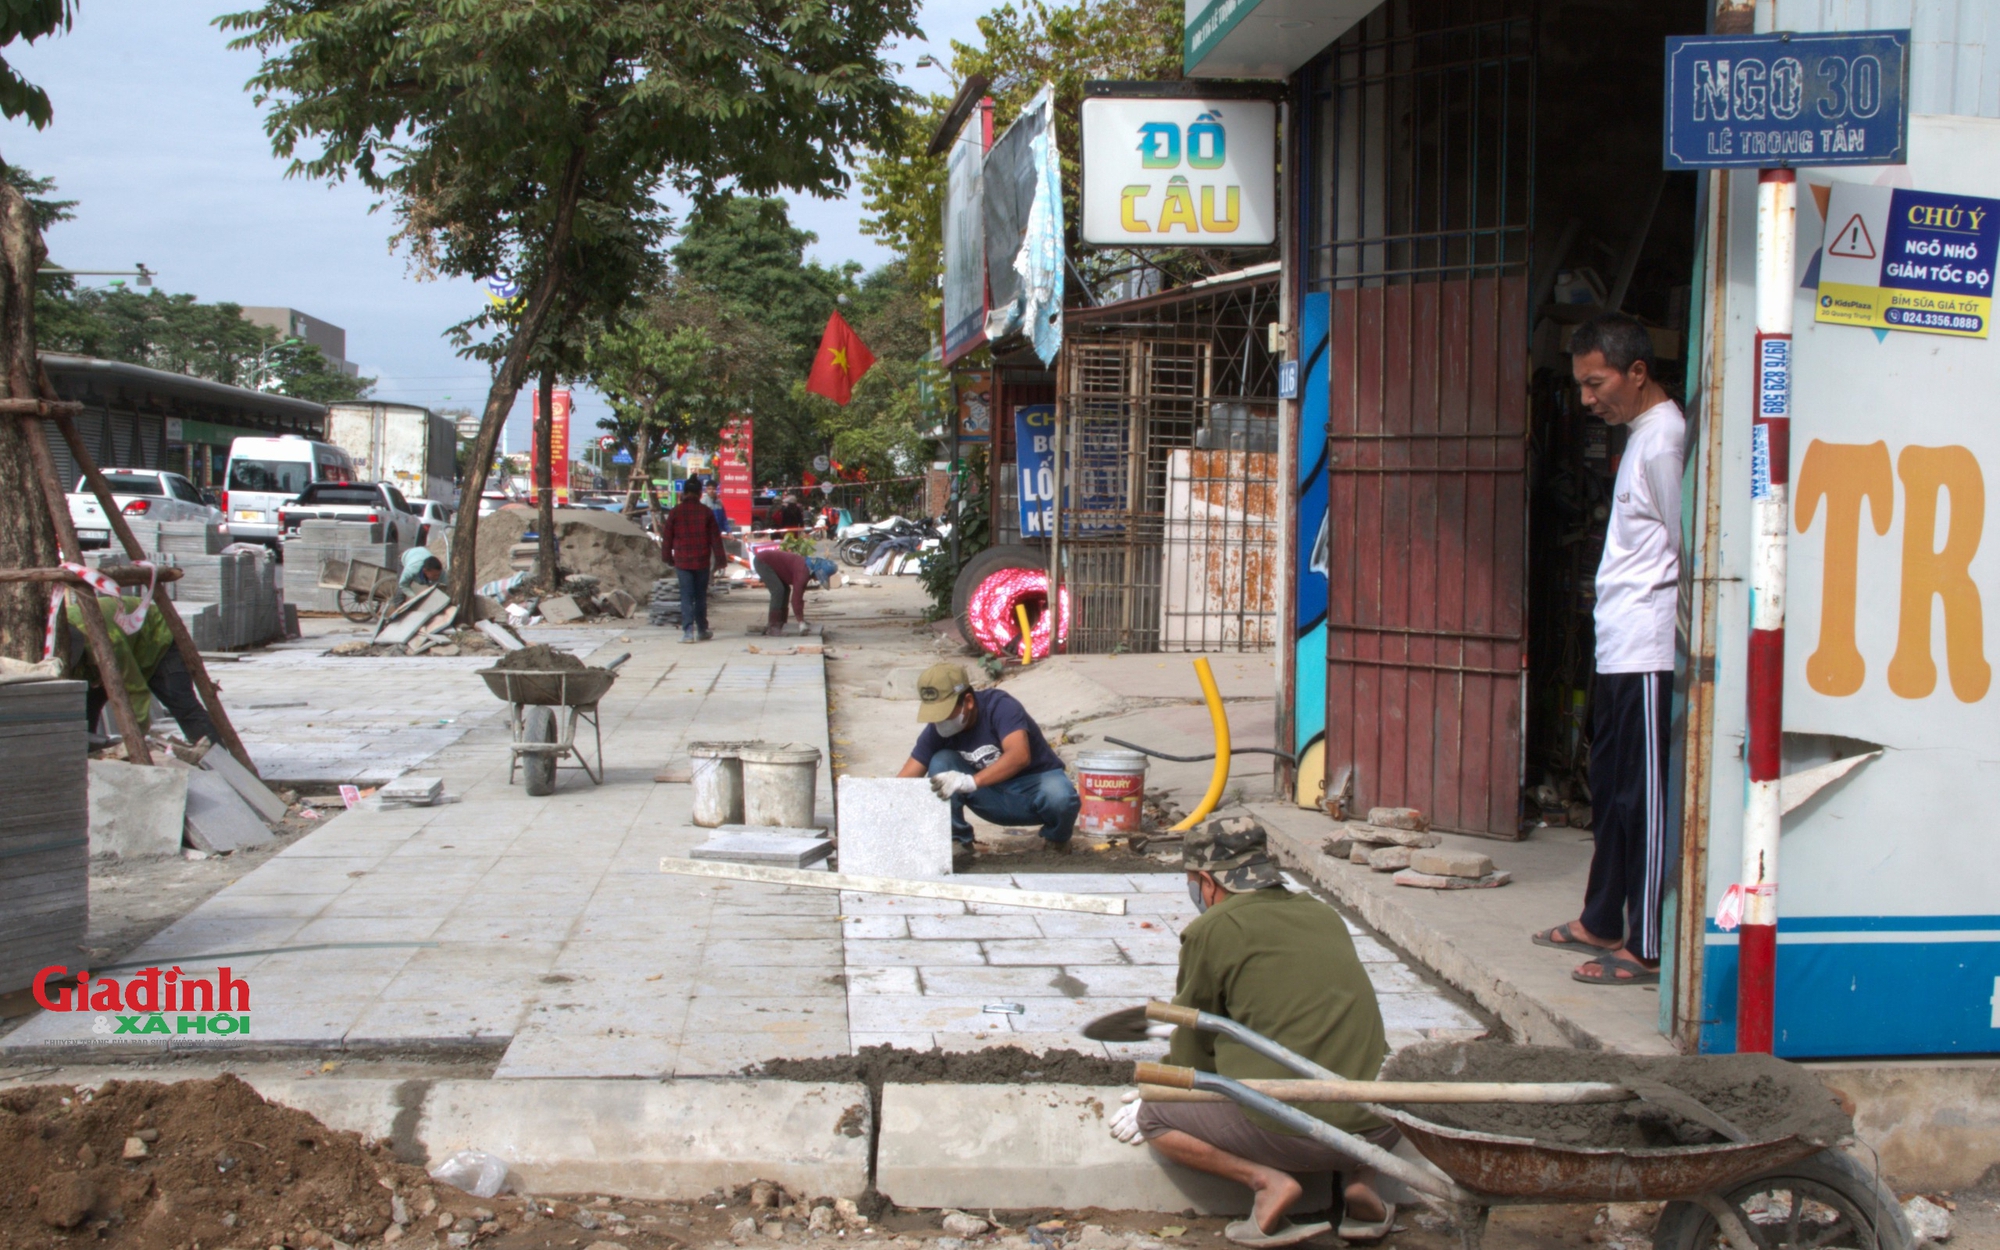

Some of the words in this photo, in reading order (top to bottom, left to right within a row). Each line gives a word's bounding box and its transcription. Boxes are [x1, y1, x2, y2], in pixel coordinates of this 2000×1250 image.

[1816, 54, 1881, 119] 30
[1136, 109, 1226, 170] ĐỒ
[1707, 127, 1733, 154] LÊ
[1820, 121, 1865, 152] TẤN
[1120, 175, 1241, 233] CÂU
[1907, 204, 1964, 228] CHÚ
[1968, 206, 1987, 230] Ý
[1904, 239, 1941, 256] NGÕ
[1943, 242, 1978, 260] NHỎ
[1886, 260, 1927, 280] GIẢM
[1930, 263, 1962, 283] TỐC
[1965, 268, 1990, 289] ĐỘ
[1853, 312, 1871, 321] Trung
[1958, 300, 1979, 312] TỐT
[1902, 311, 1979, 330] 024.3356.0888
[1281, 367, 1295, 393] 116
[1762, 341, 1787, 415] 0976.829.589
[1094, 779, 1131, 789] LUXURY
